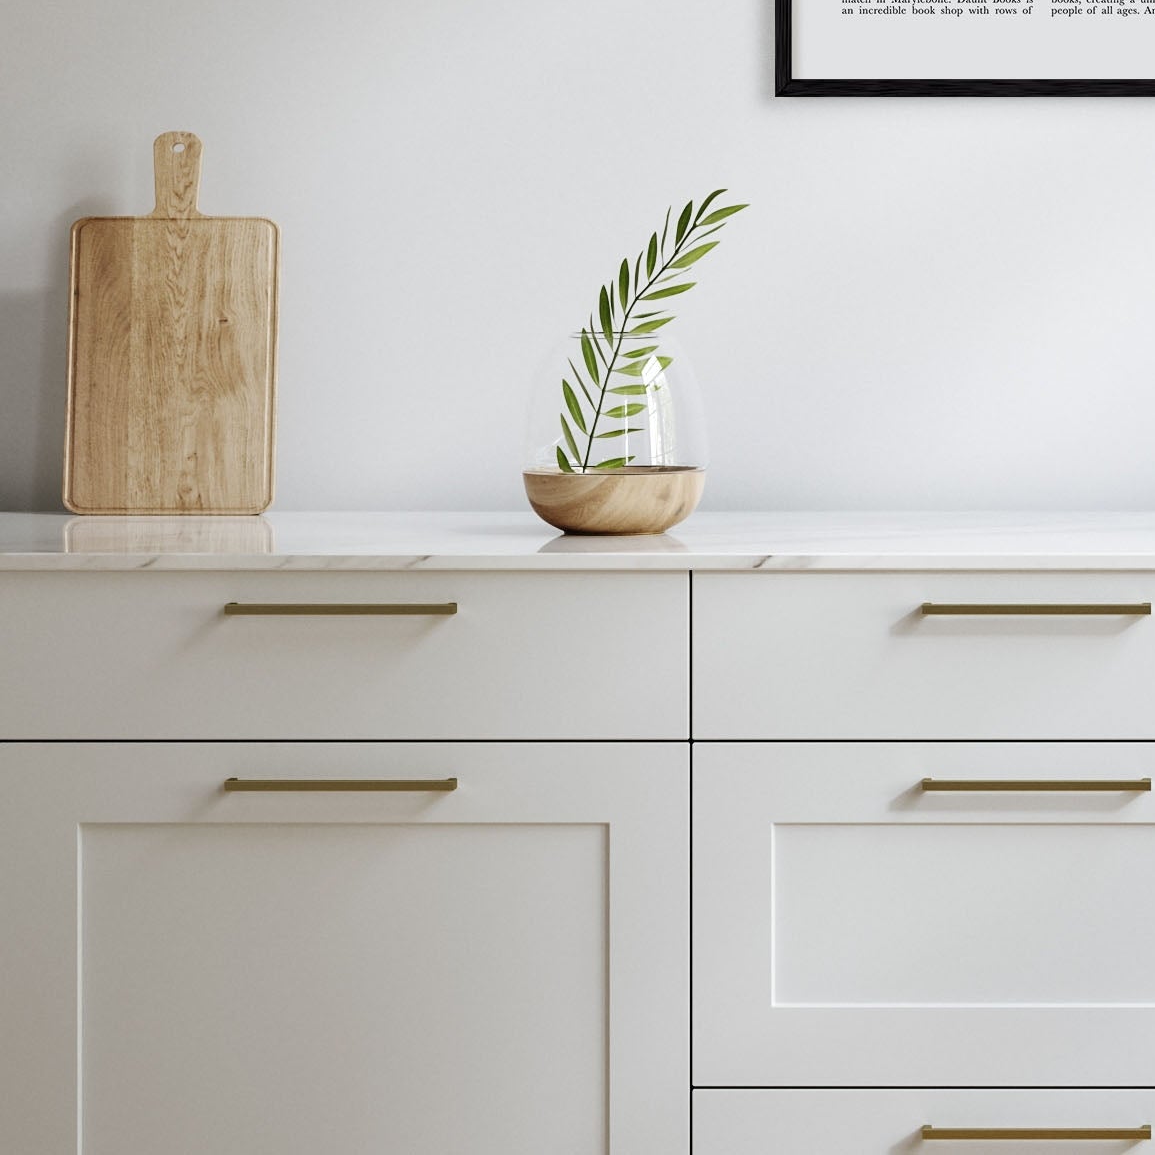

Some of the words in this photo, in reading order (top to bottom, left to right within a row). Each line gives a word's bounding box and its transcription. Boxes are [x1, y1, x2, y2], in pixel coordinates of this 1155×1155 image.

[859, 6, 906, 15] incredible
[912, 6, 935, 15] book
[941, 6, 963, 17] shop
[969, 6, 989, 15] with
[1022, 6, 1033, 15] of
[1051, 6, 1082, 17] people
[1087, 6, 1097, 15] of
[1101, 6, 1113, 15] all
[1117, 8, 1139, 17] ages.
